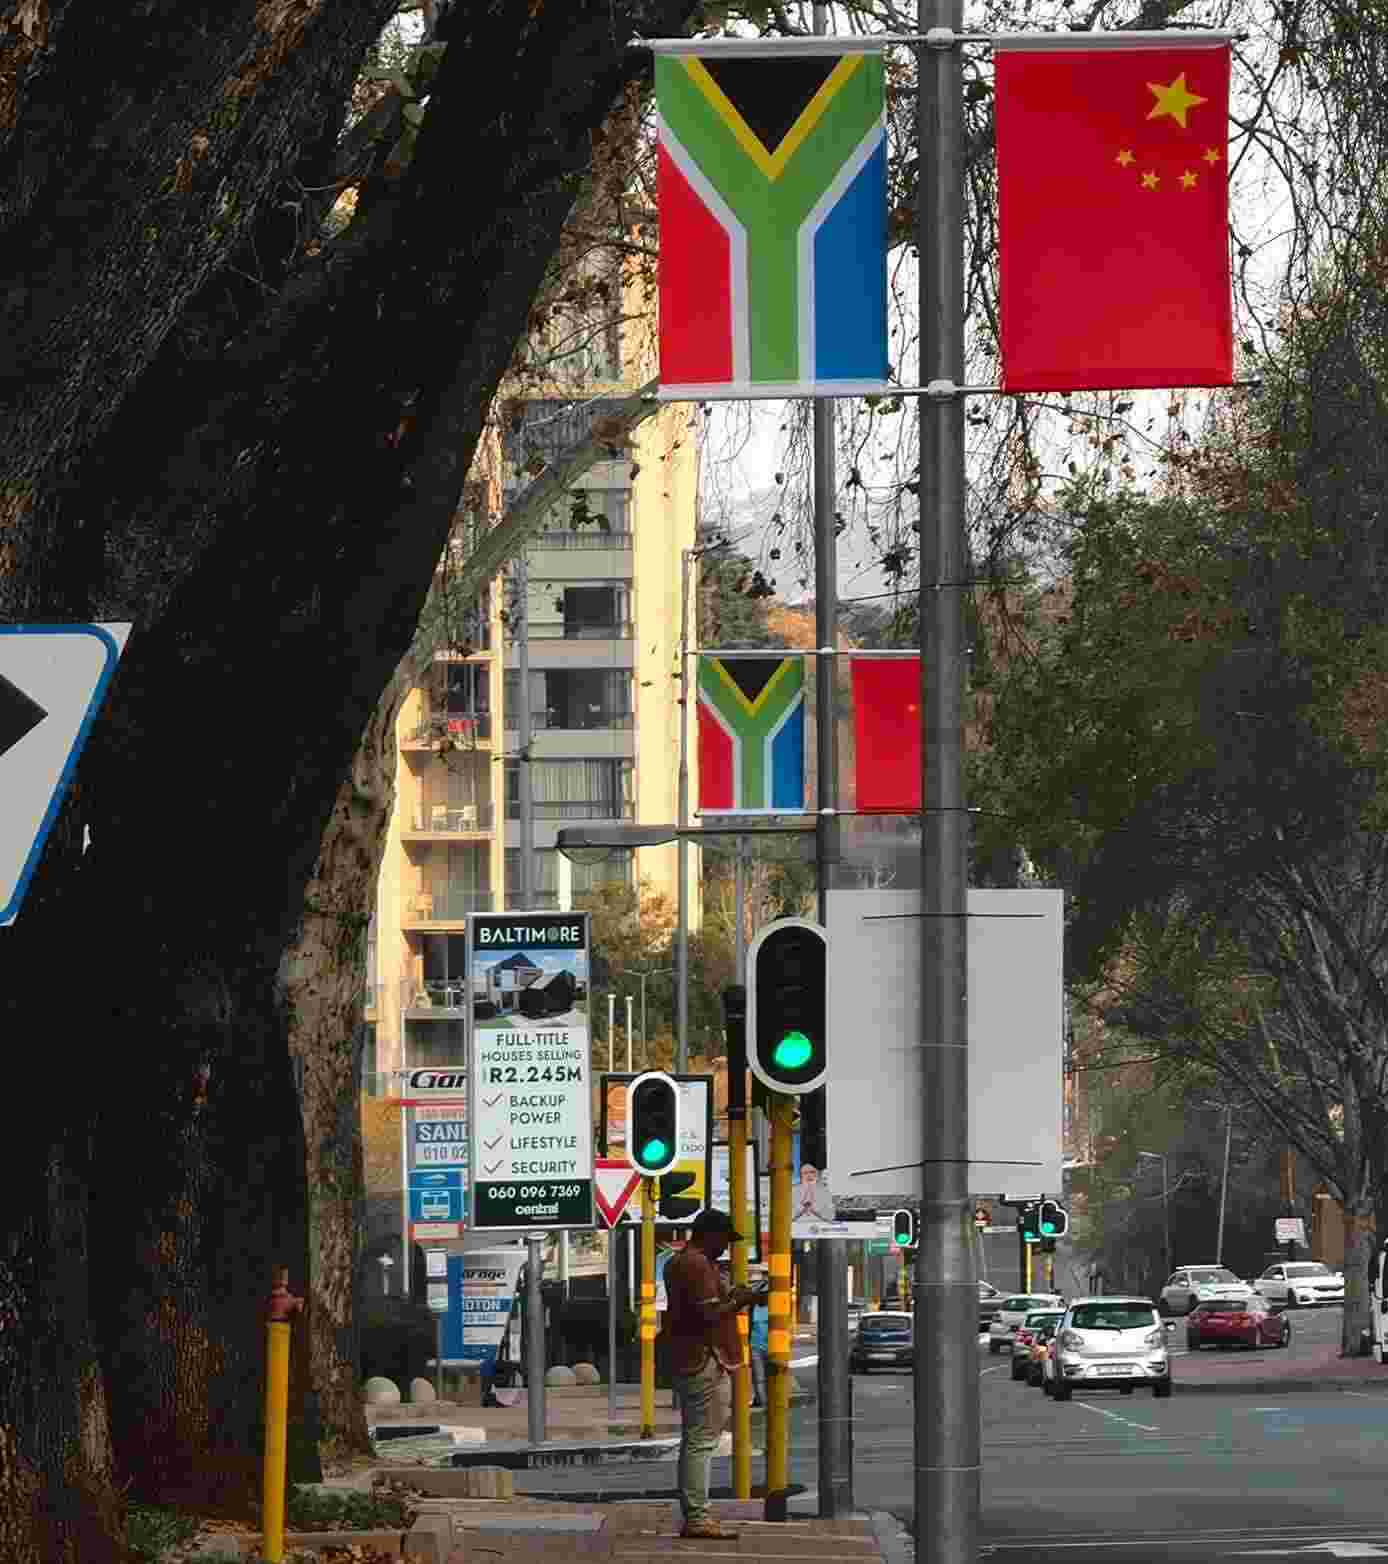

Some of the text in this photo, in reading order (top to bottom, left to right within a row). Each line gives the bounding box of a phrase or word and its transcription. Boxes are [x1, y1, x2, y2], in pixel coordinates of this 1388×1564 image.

[480, 926, 580, 943] BALTIMORE
[496, 1032, 569, 1047] FULL-TITLE
[481, 1048, 583, 1062] HOUSES SELLING
[489, 1065, 583, 1083] R2.245M
[510, 1095, 566, 1107] BACKUP
[510, 1111, 561, 1125] POWER
[511, 1135, 577, 1150] LIFESTYLE
[511, 1160, 577, 1174] SECURITY
[488, 1184, 581, 1199] 060 096 7369
